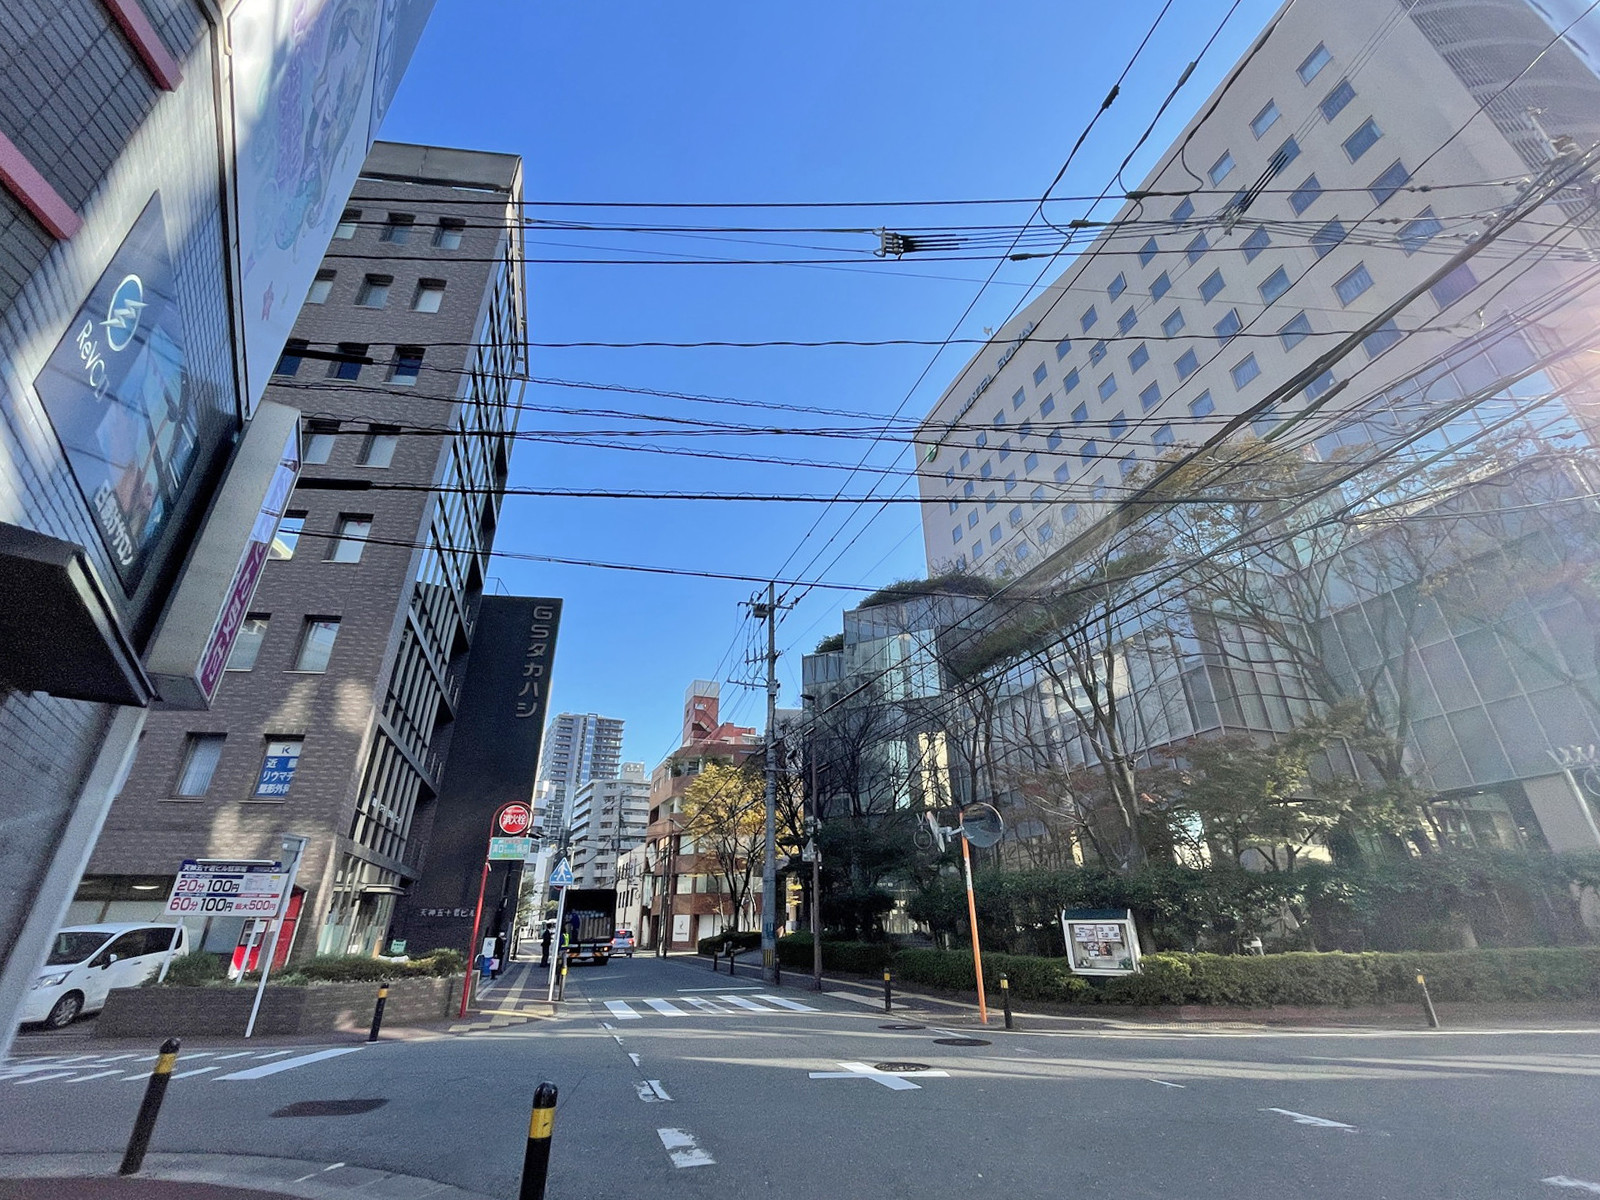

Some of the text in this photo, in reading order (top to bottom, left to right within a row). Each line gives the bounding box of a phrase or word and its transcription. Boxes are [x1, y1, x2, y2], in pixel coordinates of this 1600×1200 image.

[515, 605, 554, 718] GSタカハシ
[263, 770, 295, 782] リウマチ
[502, 814, 527, 825] 消火栓
[177, 879, 205, 892] 20分
[206, 879, 240, 892] 100円
[169, 897, 198, 911] 60分
[200, 897, 234, 912] 100円
